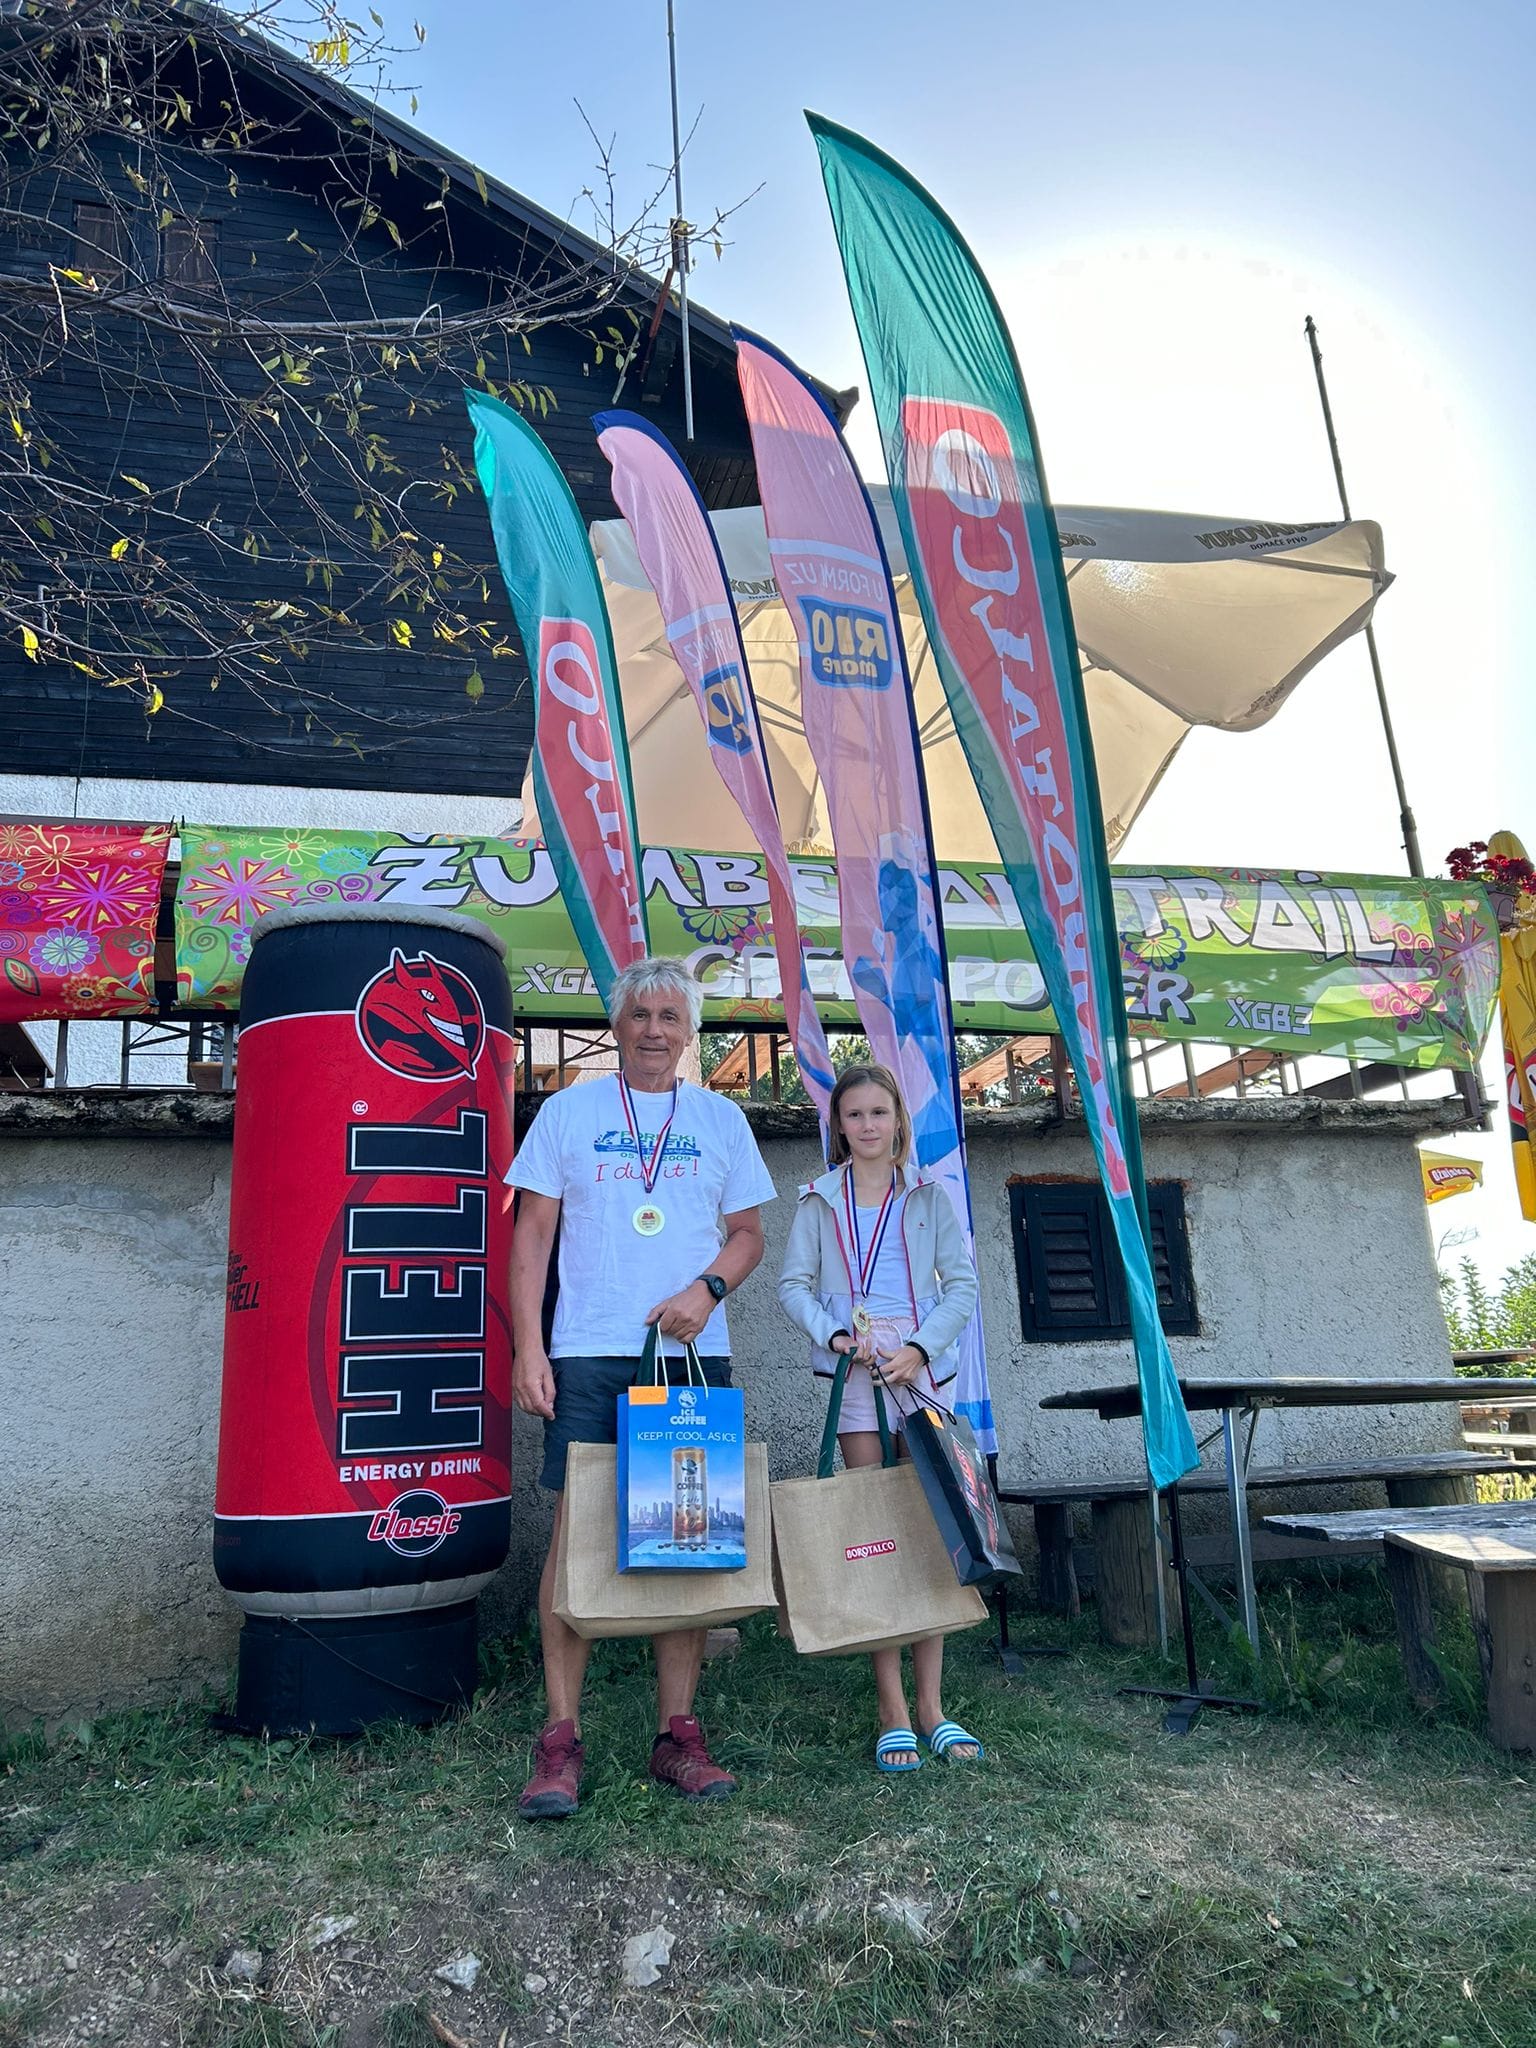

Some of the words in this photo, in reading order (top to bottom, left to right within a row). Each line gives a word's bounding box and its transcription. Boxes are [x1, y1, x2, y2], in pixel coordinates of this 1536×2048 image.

[1110, 870, 1397, 964] TRAIL
[954, 955, 1196, 1026] POER
[595, 1163, 610, 1182] I
[337, 1107, 488, 1459] HELL
[669, 1416, 707, 1425] COFFEE
[637, 1431, 663, 1441] KEEP
[665, 1431, 673, 1440] IT
[676, 1431, 705, 1441] COOL
[707, 1432, 720, 1441] AS
[722, 1432, 737, 1442] ICE
[339, 1462, 425, 1482] ENERGY
[430, 1457, 482, 1477] DRINK
[676, 1482, 704, 1491] COFFEE
[367, 1508, 462, 1542] Classic
[846, 1541, 895, 1559] BOROTALCO
